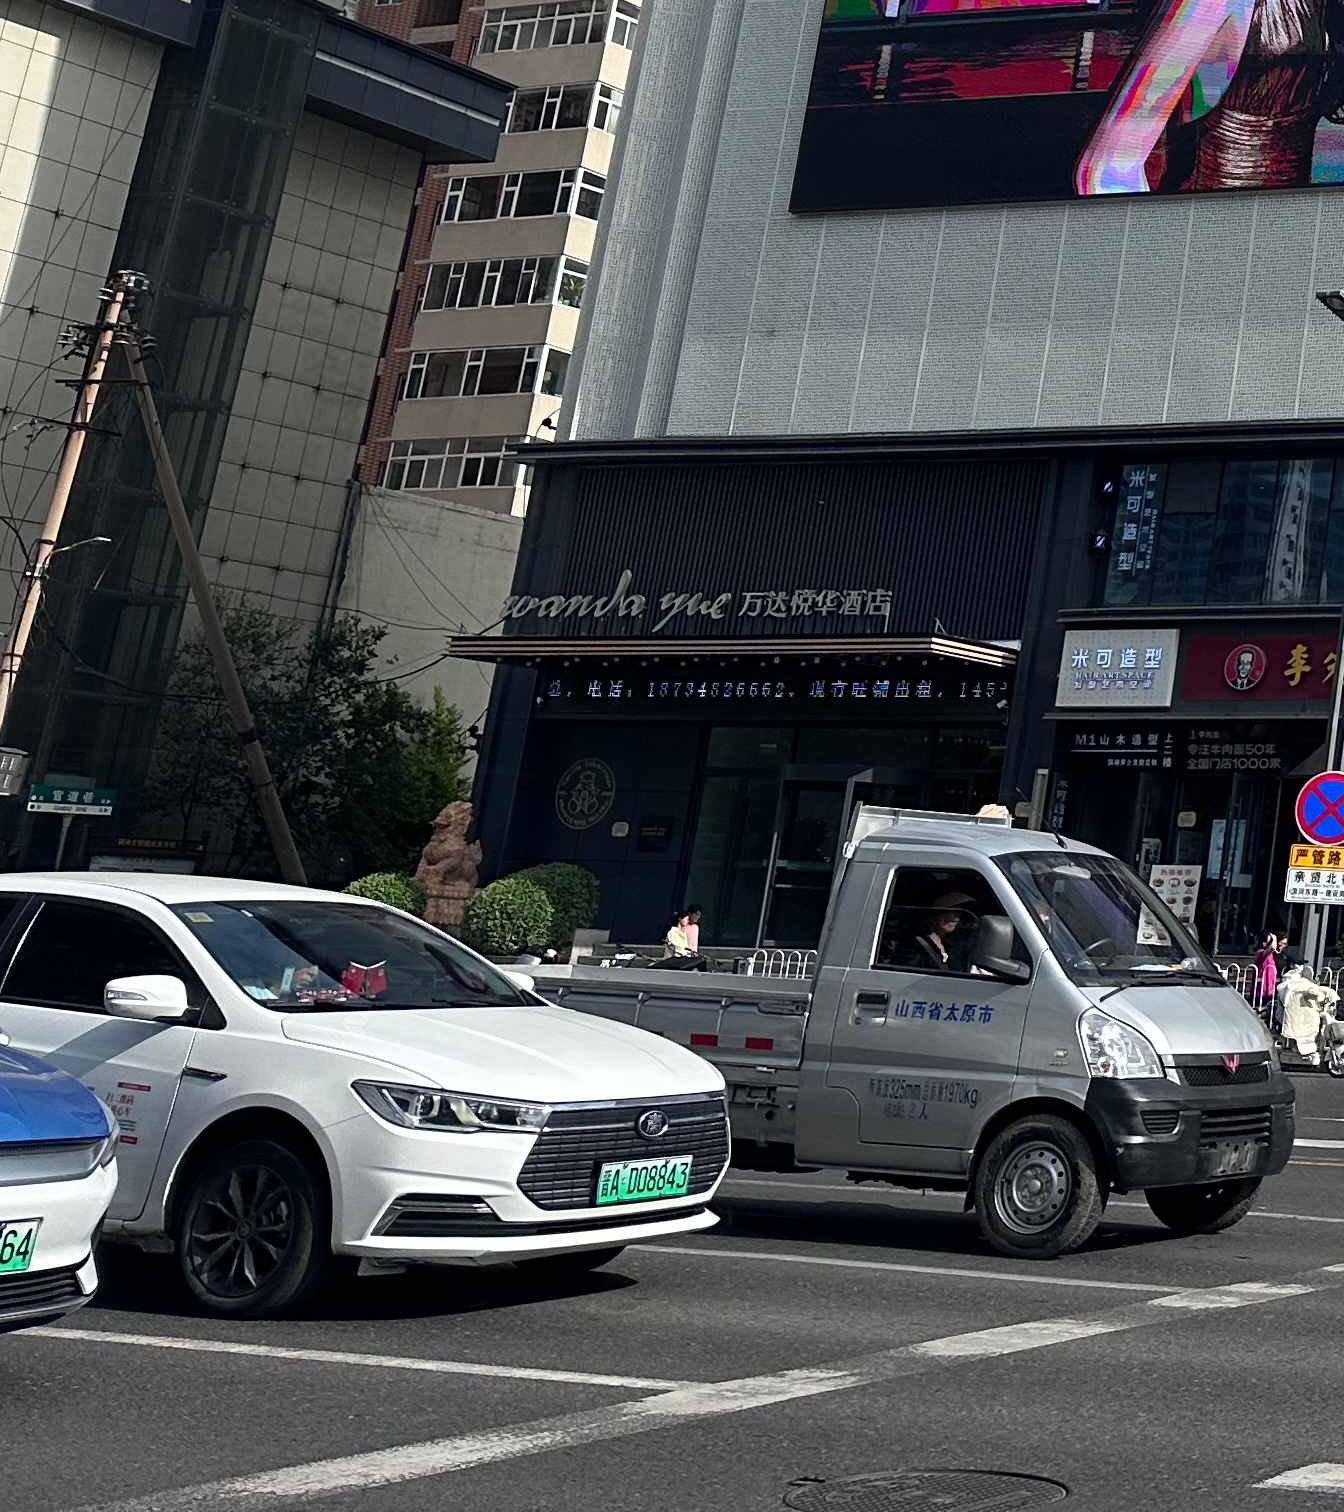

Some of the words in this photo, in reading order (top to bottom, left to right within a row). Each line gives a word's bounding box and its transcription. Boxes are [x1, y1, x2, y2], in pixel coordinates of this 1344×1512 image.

[1117, 470, 1146, 570] 米可造型
[499, 569, 647, 619] wanda
[651, 587, 732, 633] yue
[737, 588, 893, 617] 万达悦华酒店
[1071, 647, 1163, 669] 米可造型
[894, 999, 995, 1024] 山西省太原市
